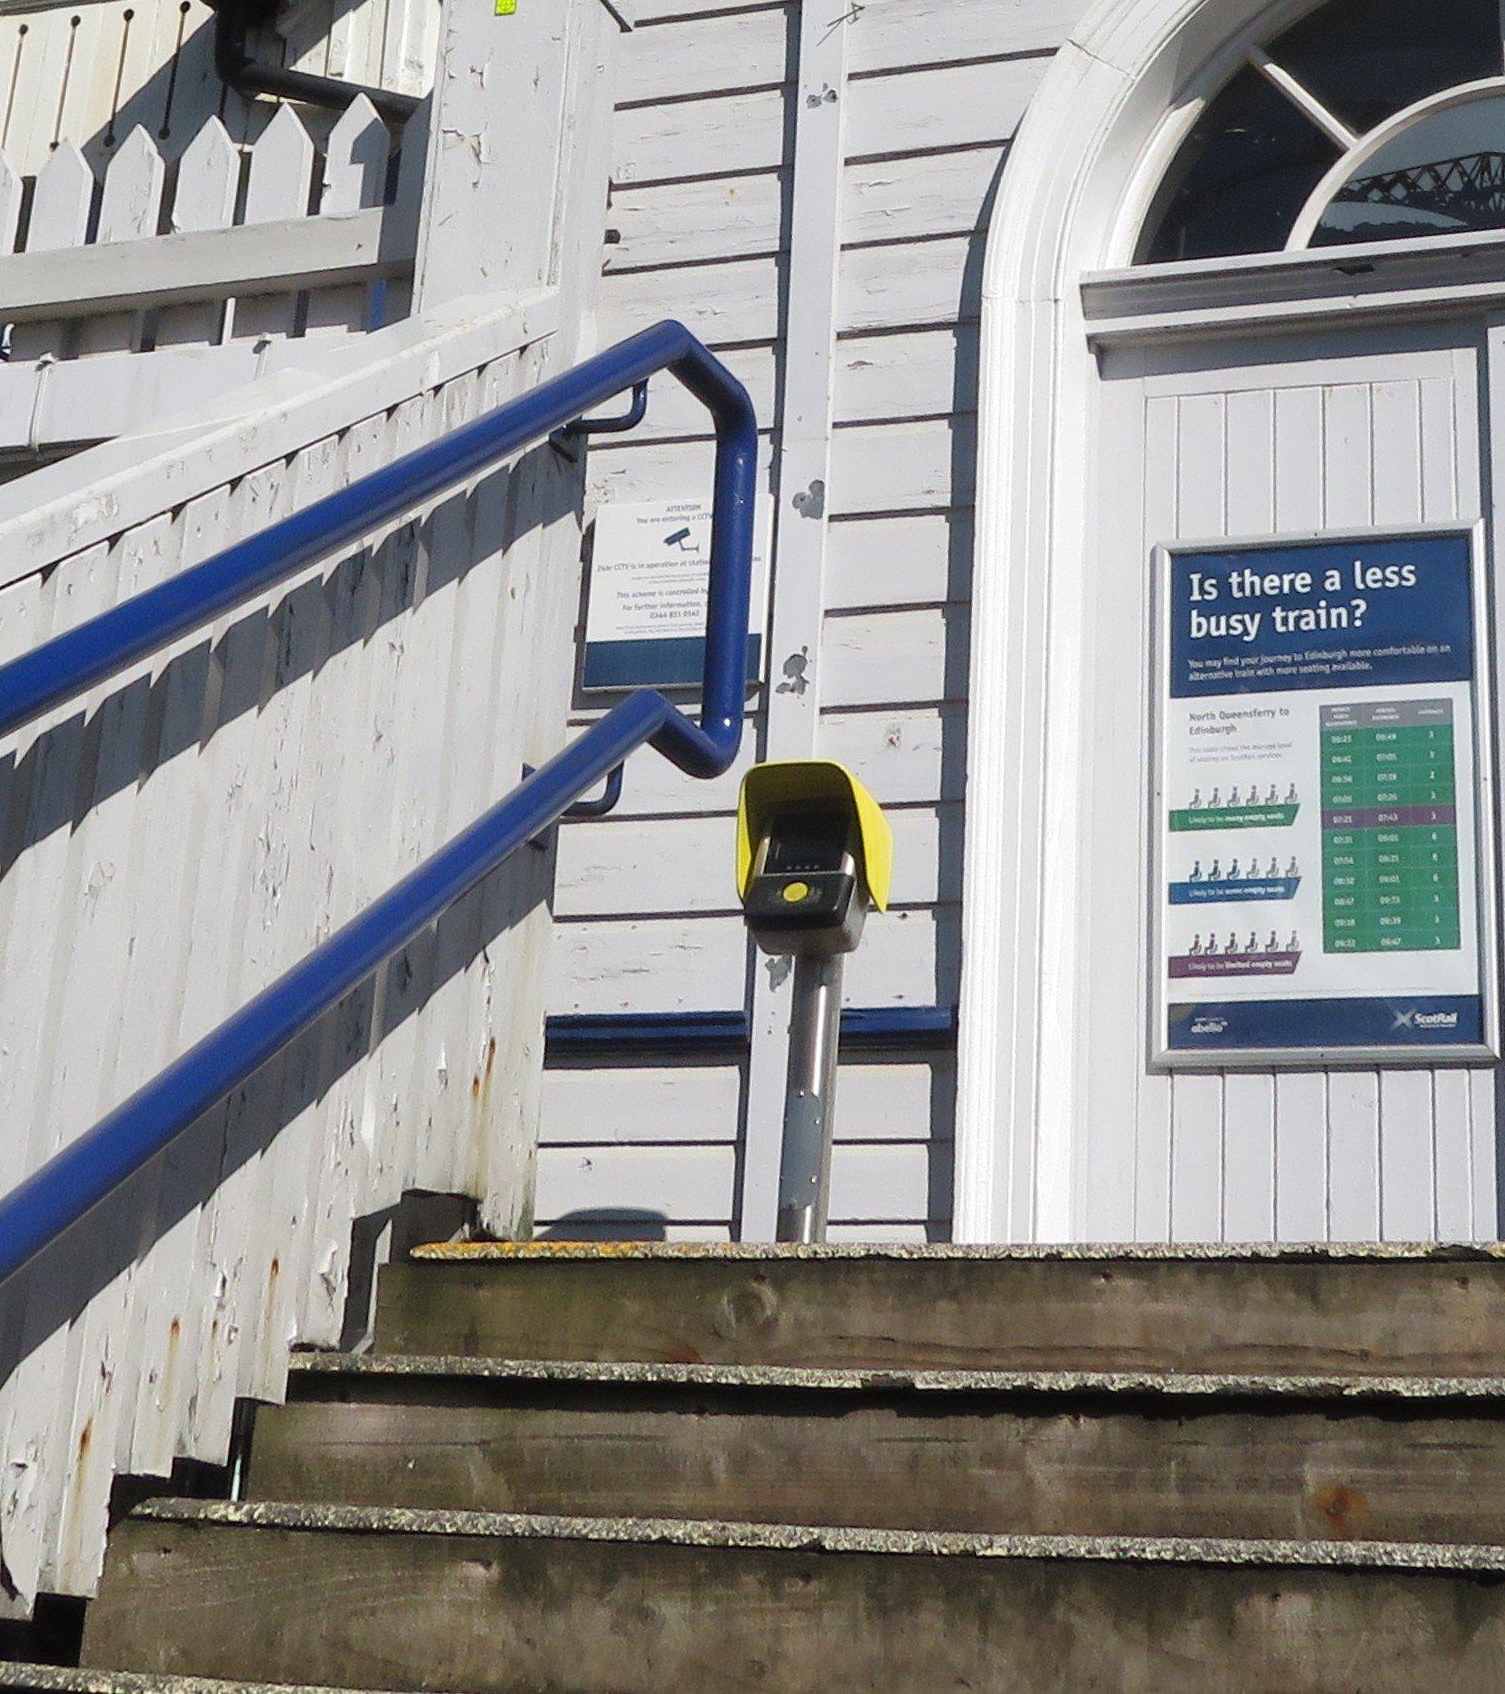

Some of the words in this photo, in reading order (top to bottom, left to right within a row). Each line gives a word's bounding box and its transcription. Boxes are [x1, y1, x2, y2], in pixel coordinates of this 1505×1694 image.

[1188, 572, 1219, 602] Is
[1228, 567, 1312, 599] there
[1323, 568, 1342, 592] a
[1353, 559, 1417, 590] less
[1189, 607, 1262, 643] busy
[1271, 597, 1368, 633] train?
[1188, 658, 1204, 668] You
[1205, 659, 1222, 669] may
[1305, 648, 1348, 661] Edinburgh
[1349, 649, 1371, 658] more
[1372, 645, 1425, 657] comfortable
[1189, 711, 1216, 722] North
[1219, 707, 1276, 721] Queensferry
[1279, 707, 1290, 716] to
[1189, 724, 1237, 736] Edinburgh
[1413, 1012, 1458, 1025] ScotRail
